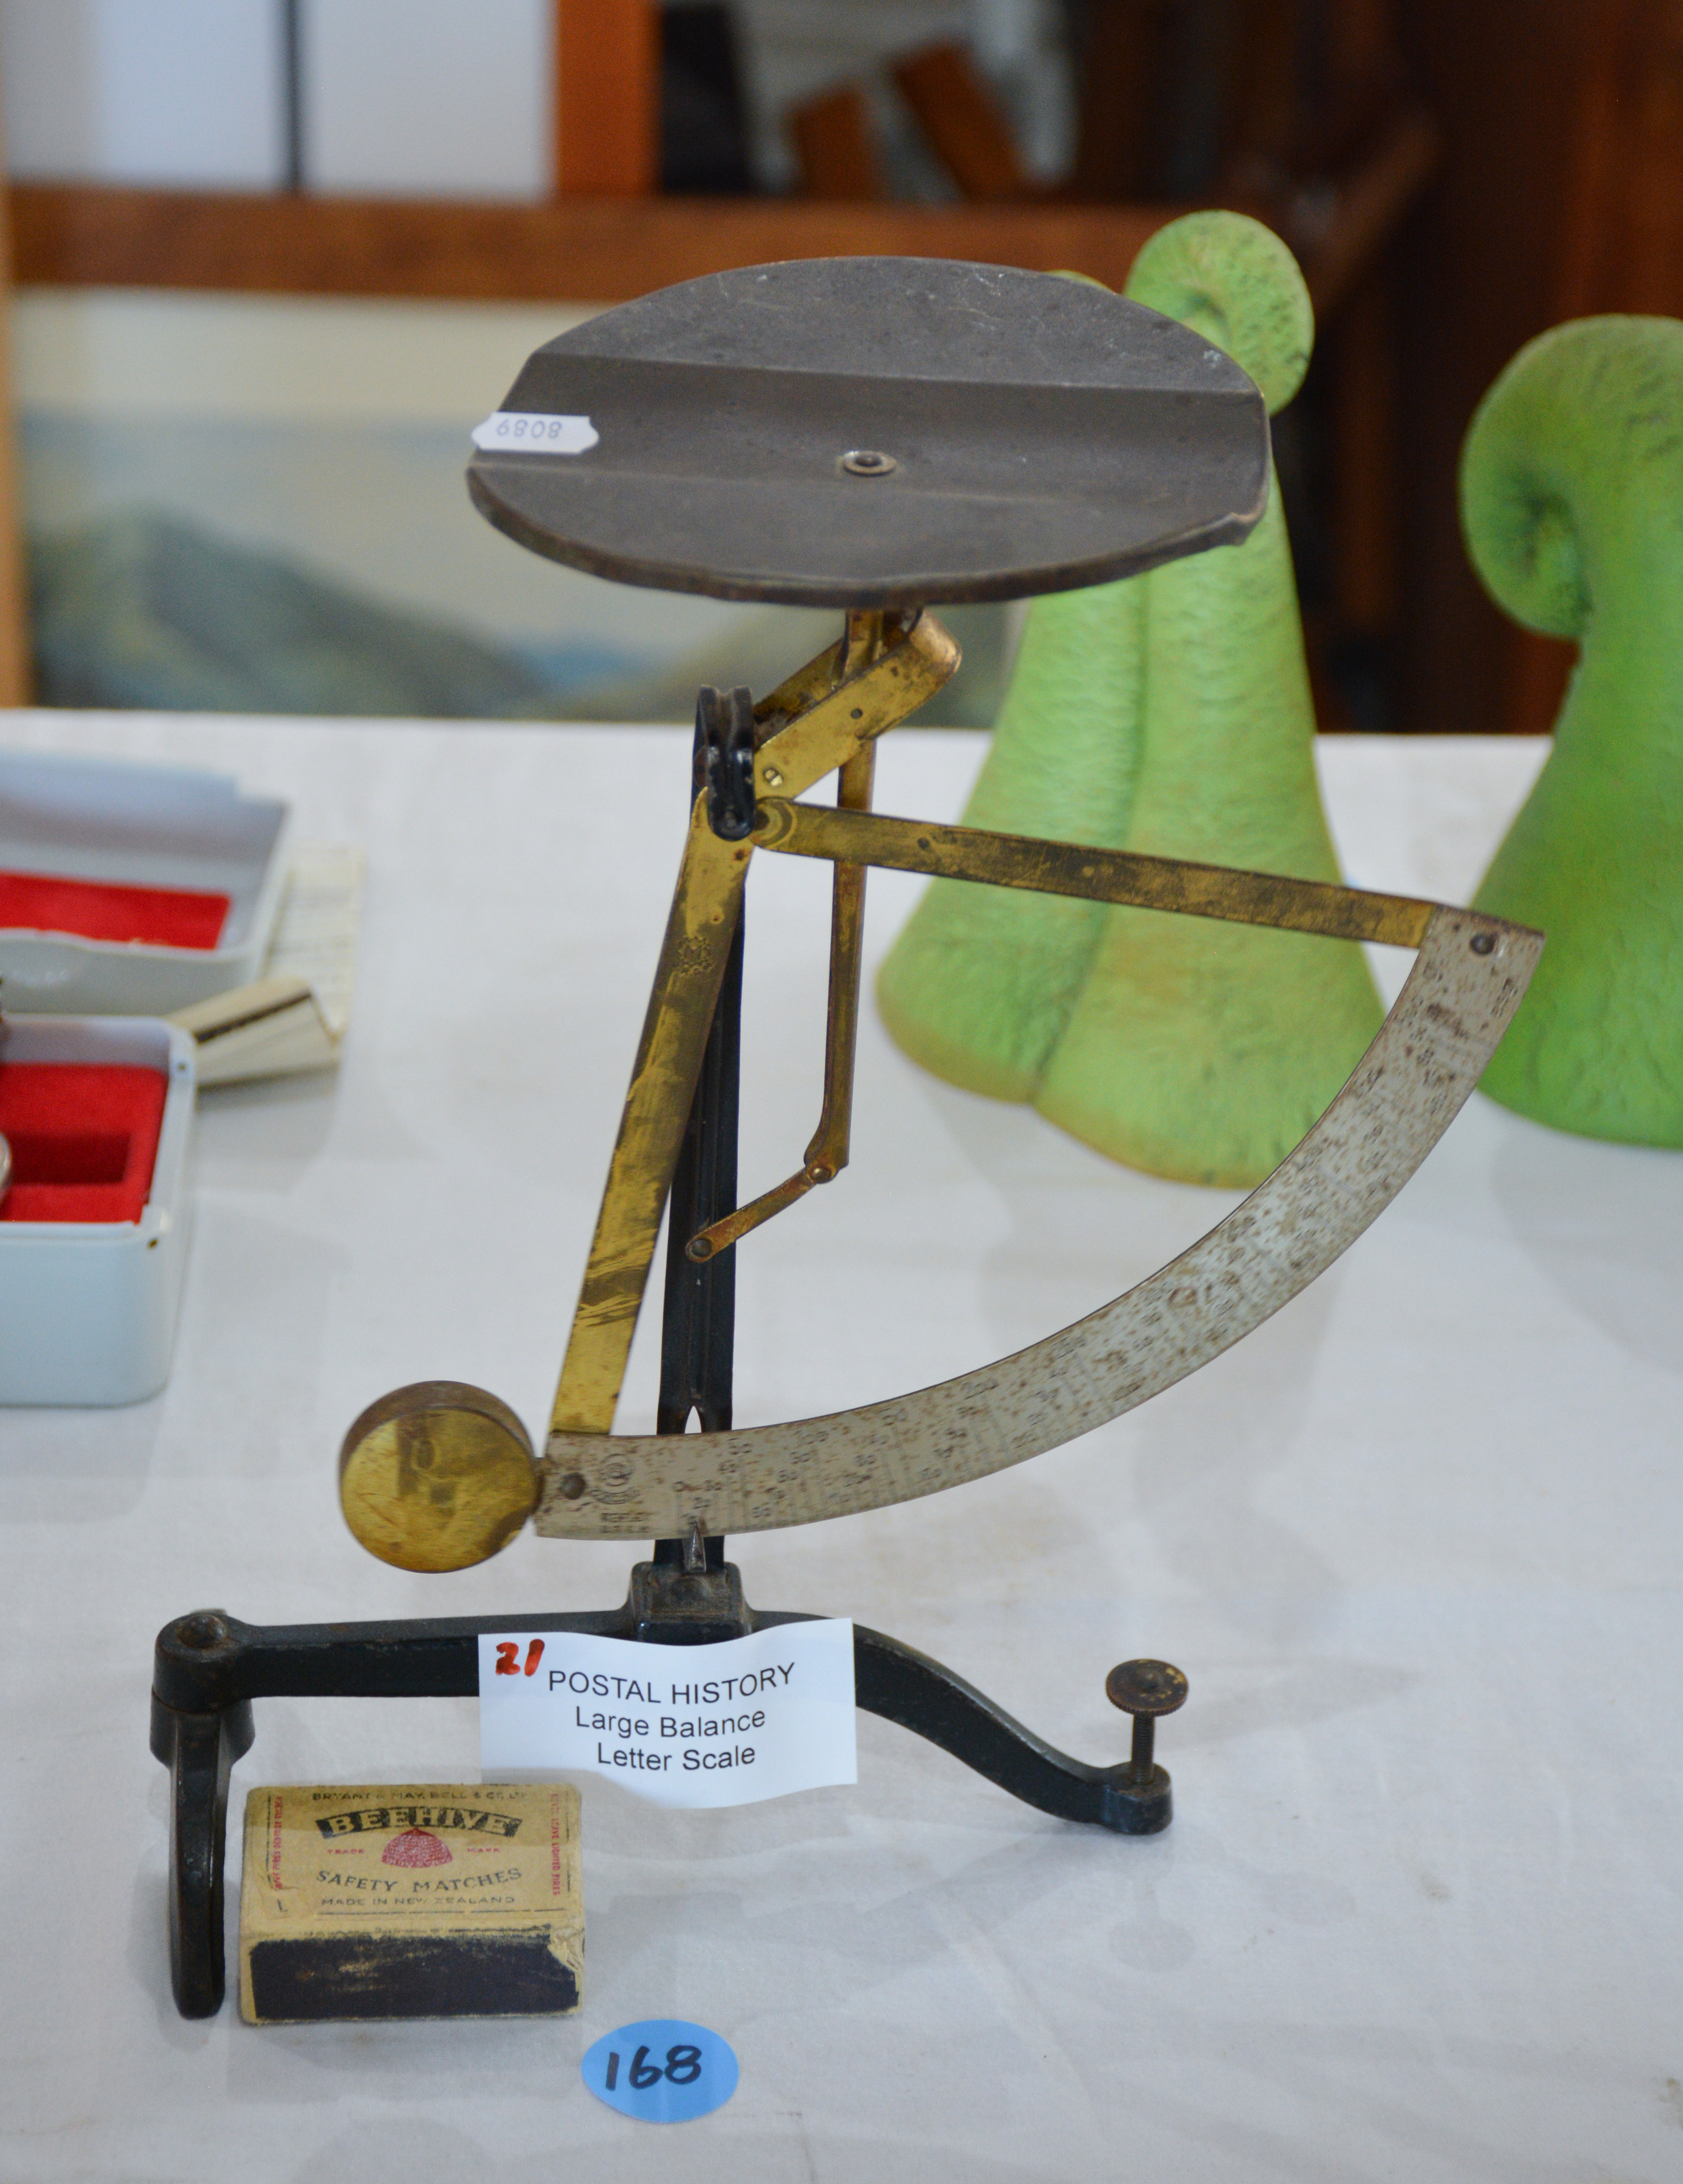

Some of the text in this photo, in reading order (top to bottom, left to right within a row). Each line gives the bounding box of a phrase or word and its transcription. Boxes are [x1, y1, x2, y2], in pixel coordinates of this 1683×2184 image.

[495, 1639, 545, 1677] 21
[548, 1663, 795, 1705] POSTAL HISTORY
[576, 1706, 766, 1739] Large Balance
[597, 1742, 756, 1771] Letter Scale
[327, 1807, 514, 1837] BEEHIVE
[316, 1868, 523, 1893] SAFETY MATCHES
[552, 1873, 561, 1896] FIRES
[322, 1896, 515, 1906] MADE IN NEW ZEALAND
[605, 2045, 702, 2091] 168
